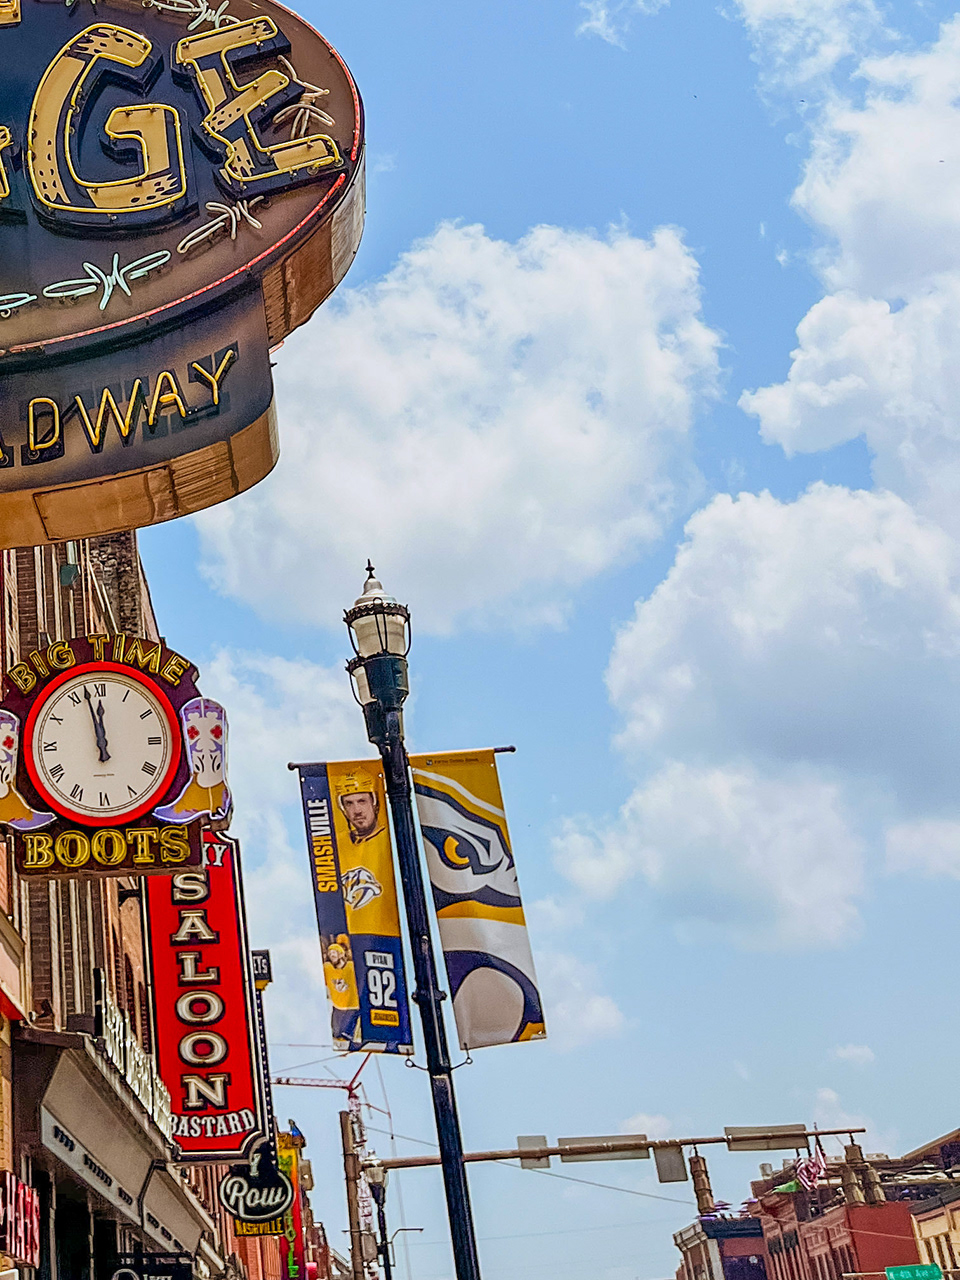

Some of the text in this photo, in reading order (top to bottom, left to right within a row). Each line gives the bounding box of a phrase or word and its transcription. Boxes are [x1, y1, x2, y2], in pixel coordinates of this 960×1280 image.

[7, 632, 190, 695] BIG TIME
[21, 825, 192, 870] BOOTS
[306, 797, 339, 893] SMASHVILLE
[170, 872, 231, 1109] SALOON
[367, 968, 399, 1009] 92
[170, 1108, 256, 1138] BASTARD
[225, 1175, 287, 1218] Row
